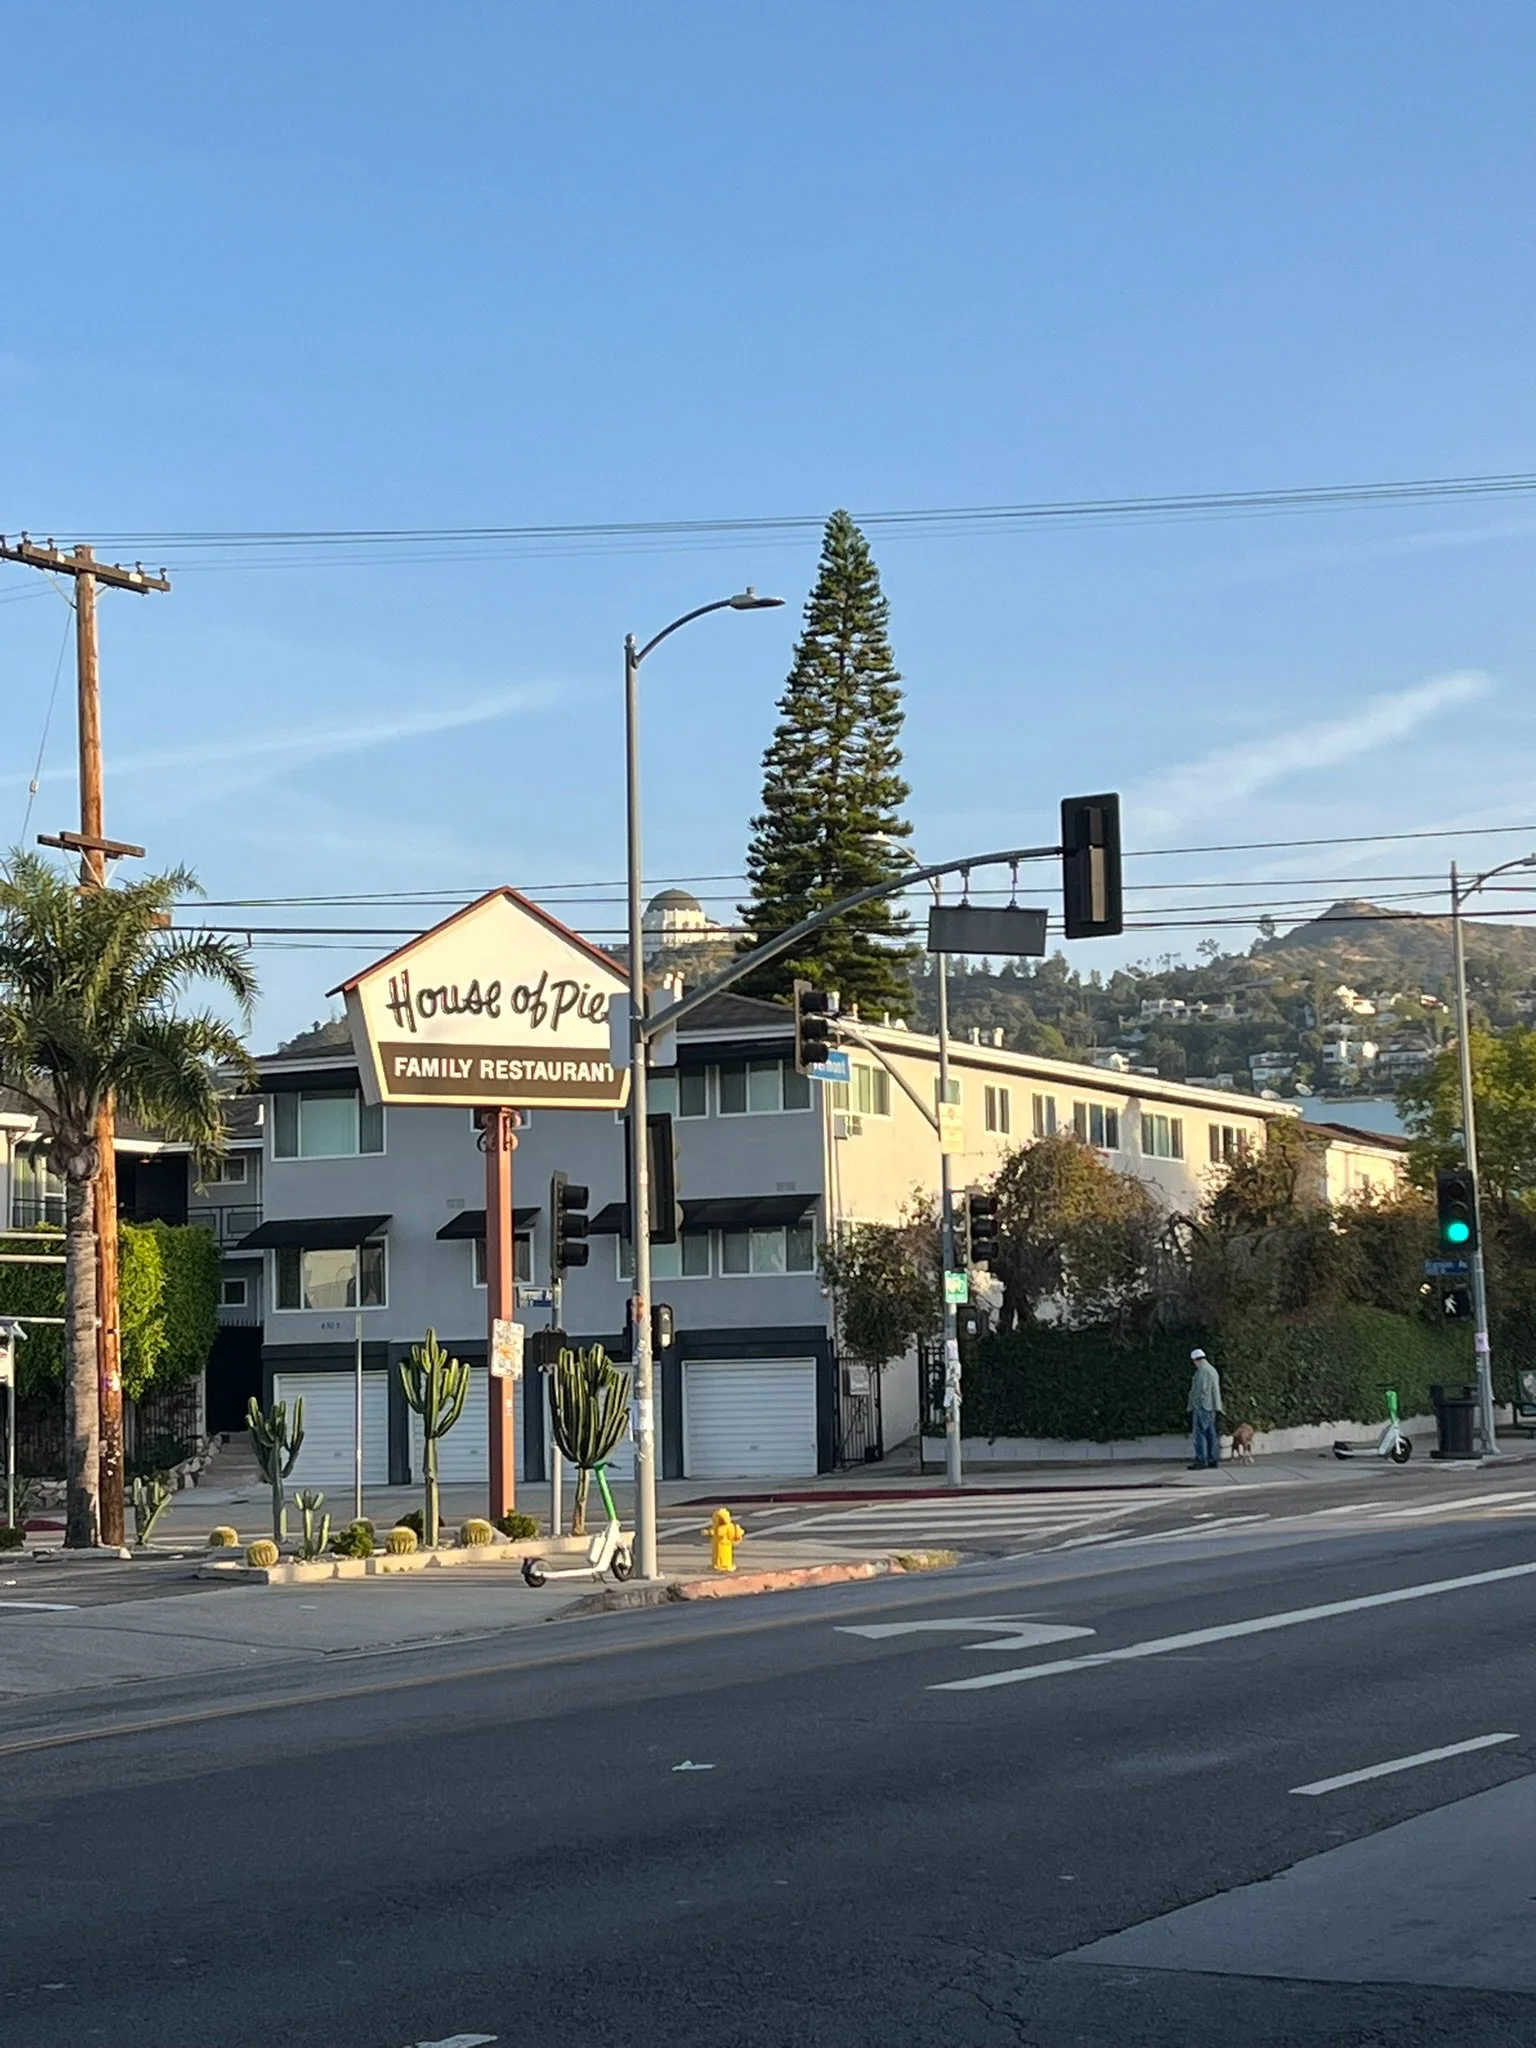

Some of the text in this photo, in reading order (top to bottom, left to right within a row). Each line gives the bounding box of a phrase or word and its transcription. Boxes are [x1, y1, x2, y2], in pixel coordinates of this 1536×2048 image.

[386, 969, 610, 1032] House of Pie
[394, 1056, 615, 1082] FAMILY RESTAURANT
